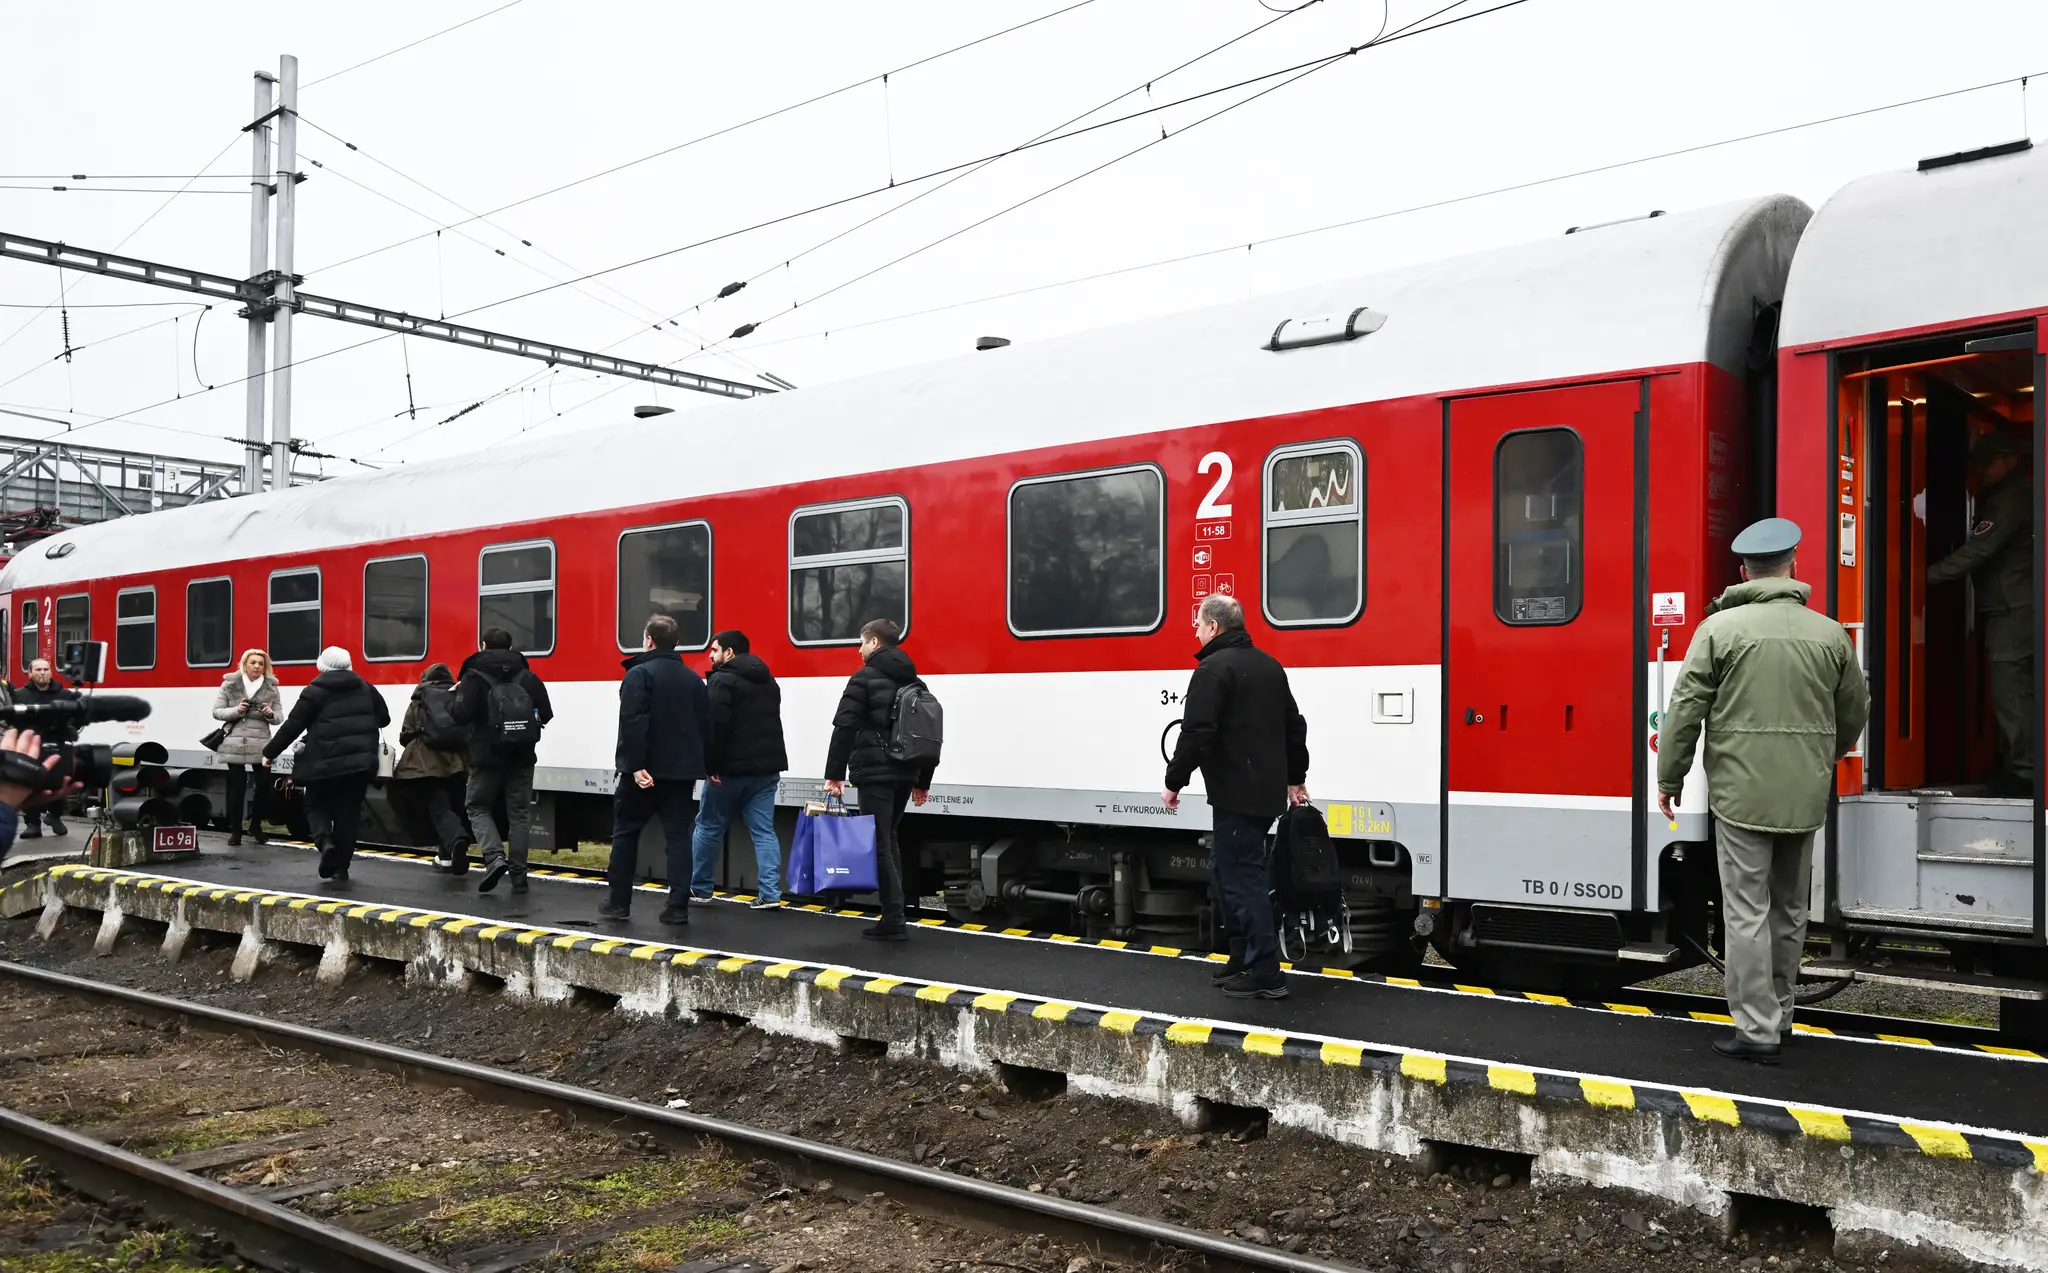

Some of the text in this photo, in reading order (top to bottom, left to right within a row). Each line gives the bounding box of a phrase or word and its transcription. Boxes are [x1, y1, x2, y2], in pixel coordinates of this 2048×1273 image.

[1196, 451, 1233, 519] 2
[1203, 525, 1225, 536] 11-58
[44, 596, 52, 626] 2
[928, 795, 975, 805] SVETLENIE 24V
[1353, 806, 1365, 818] 16
[160, 832, 192, 846] Lc 9a
[1419, 855, 1430, 863] WC
[1522, 879, 1544, 895] TB
[1563, 882, 1569, 896] /
[1573, 882, 1624, 900] SSOD
